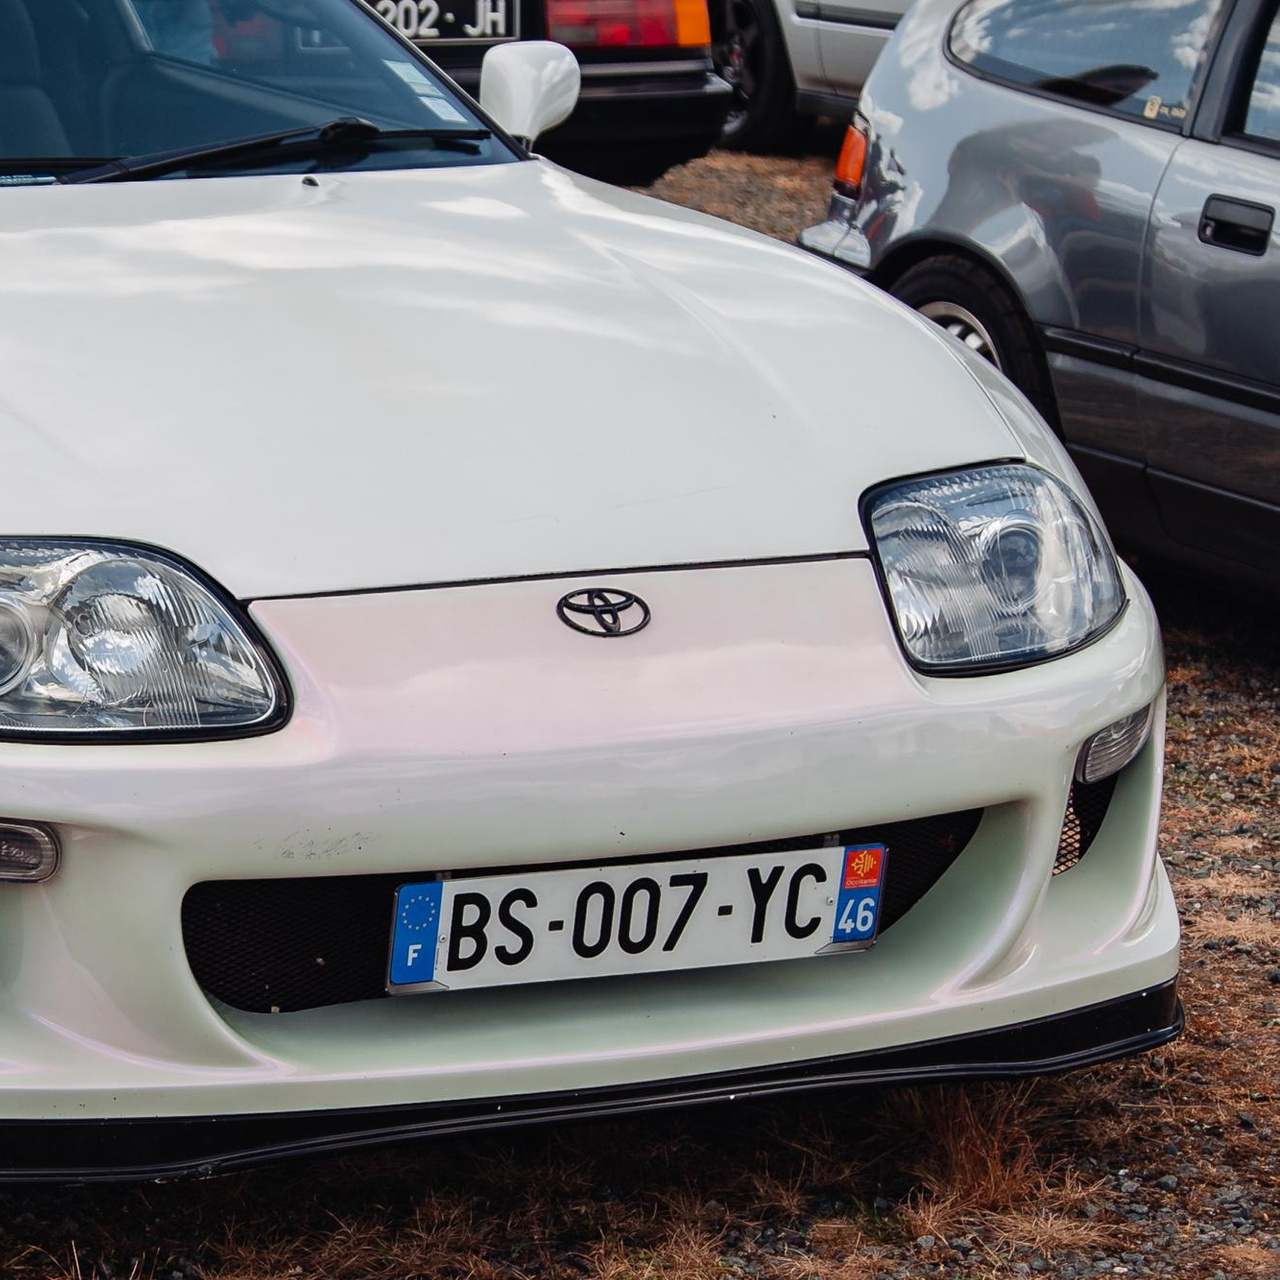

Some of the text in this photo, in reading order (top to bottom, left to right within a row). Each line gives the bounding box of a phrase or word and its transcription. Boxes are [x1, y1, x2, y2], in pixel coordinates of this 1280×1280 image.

[845, 878, 878, 886] Occitanie
[406, 943, 422, 967] F
[446, 862, 828, 972] BS-007-YC
[837, 897, 876, 933] 46
